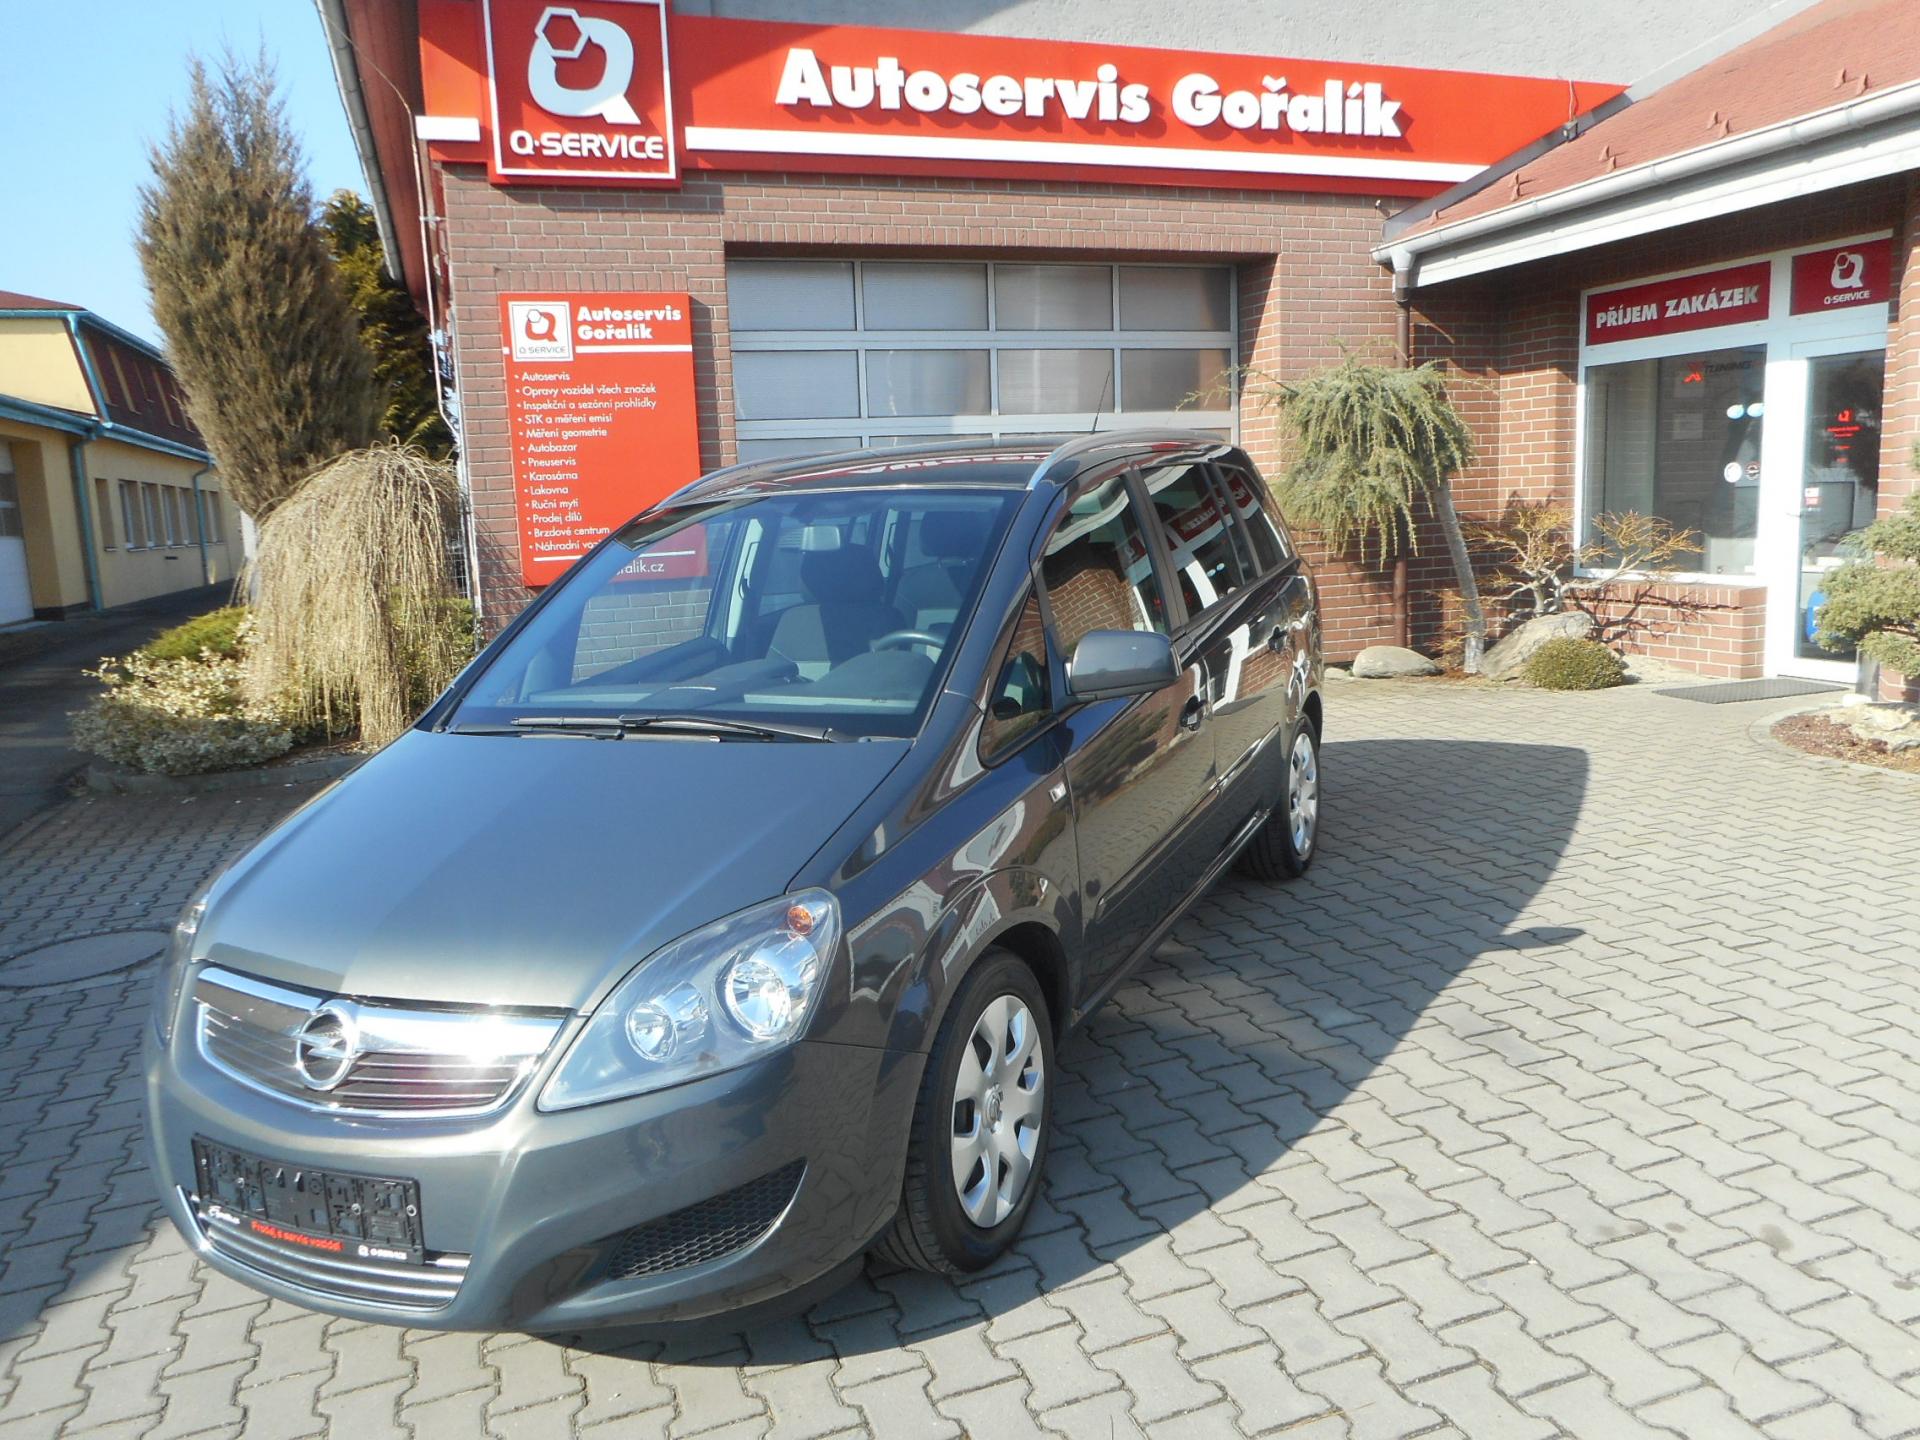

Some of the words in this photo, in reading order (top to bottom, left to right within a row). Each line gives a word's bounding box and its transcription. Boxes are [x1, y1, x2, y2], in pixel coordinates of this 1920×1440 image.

[775, 48, 1150, 123] Autoservis
[1172, 73, 1403, 137] Gořalík
[1596, 303, 1657, 328] PŘÍJEM
[1664, 285, 1759, 318] ZAKÁZEK
[577, 305, 682, 322] Autoservis
[577, 324, 653, 340] Gořalík
[522, 372, 570, 381] Autoservis
[522, 386, 558, 397] Opravy
[562, 385, 594, 395] vozidel
[597, 384, 621, 394] všech
[624, 383, 656, 393] značek
[523, 400, 566, 412] Inspekční
[578, 399, 612, 409] sezónní
[615, 398, 656, 411] prohlídky
[525, 415, 543, 425] STK
[555, 414, 586, 424] měření
[526, 428, 559, 438] Měření
[562, 428, 608, 439] geometrie
[528, 442, 577, 453] Autobazar
[528, 457, 576, 467] Pneuservis
[529, 471, 578, 481] Karosárna
[530, 485, 569, 495] Lakovna
[532, 499, 557, 509] Ruční
[533, 513, 562, 525] Prodej
[534, 527, 571, 538] Brzdové
[574, 527, 610, 536] centrum
[535, 540, 580, 551] Náhradní
